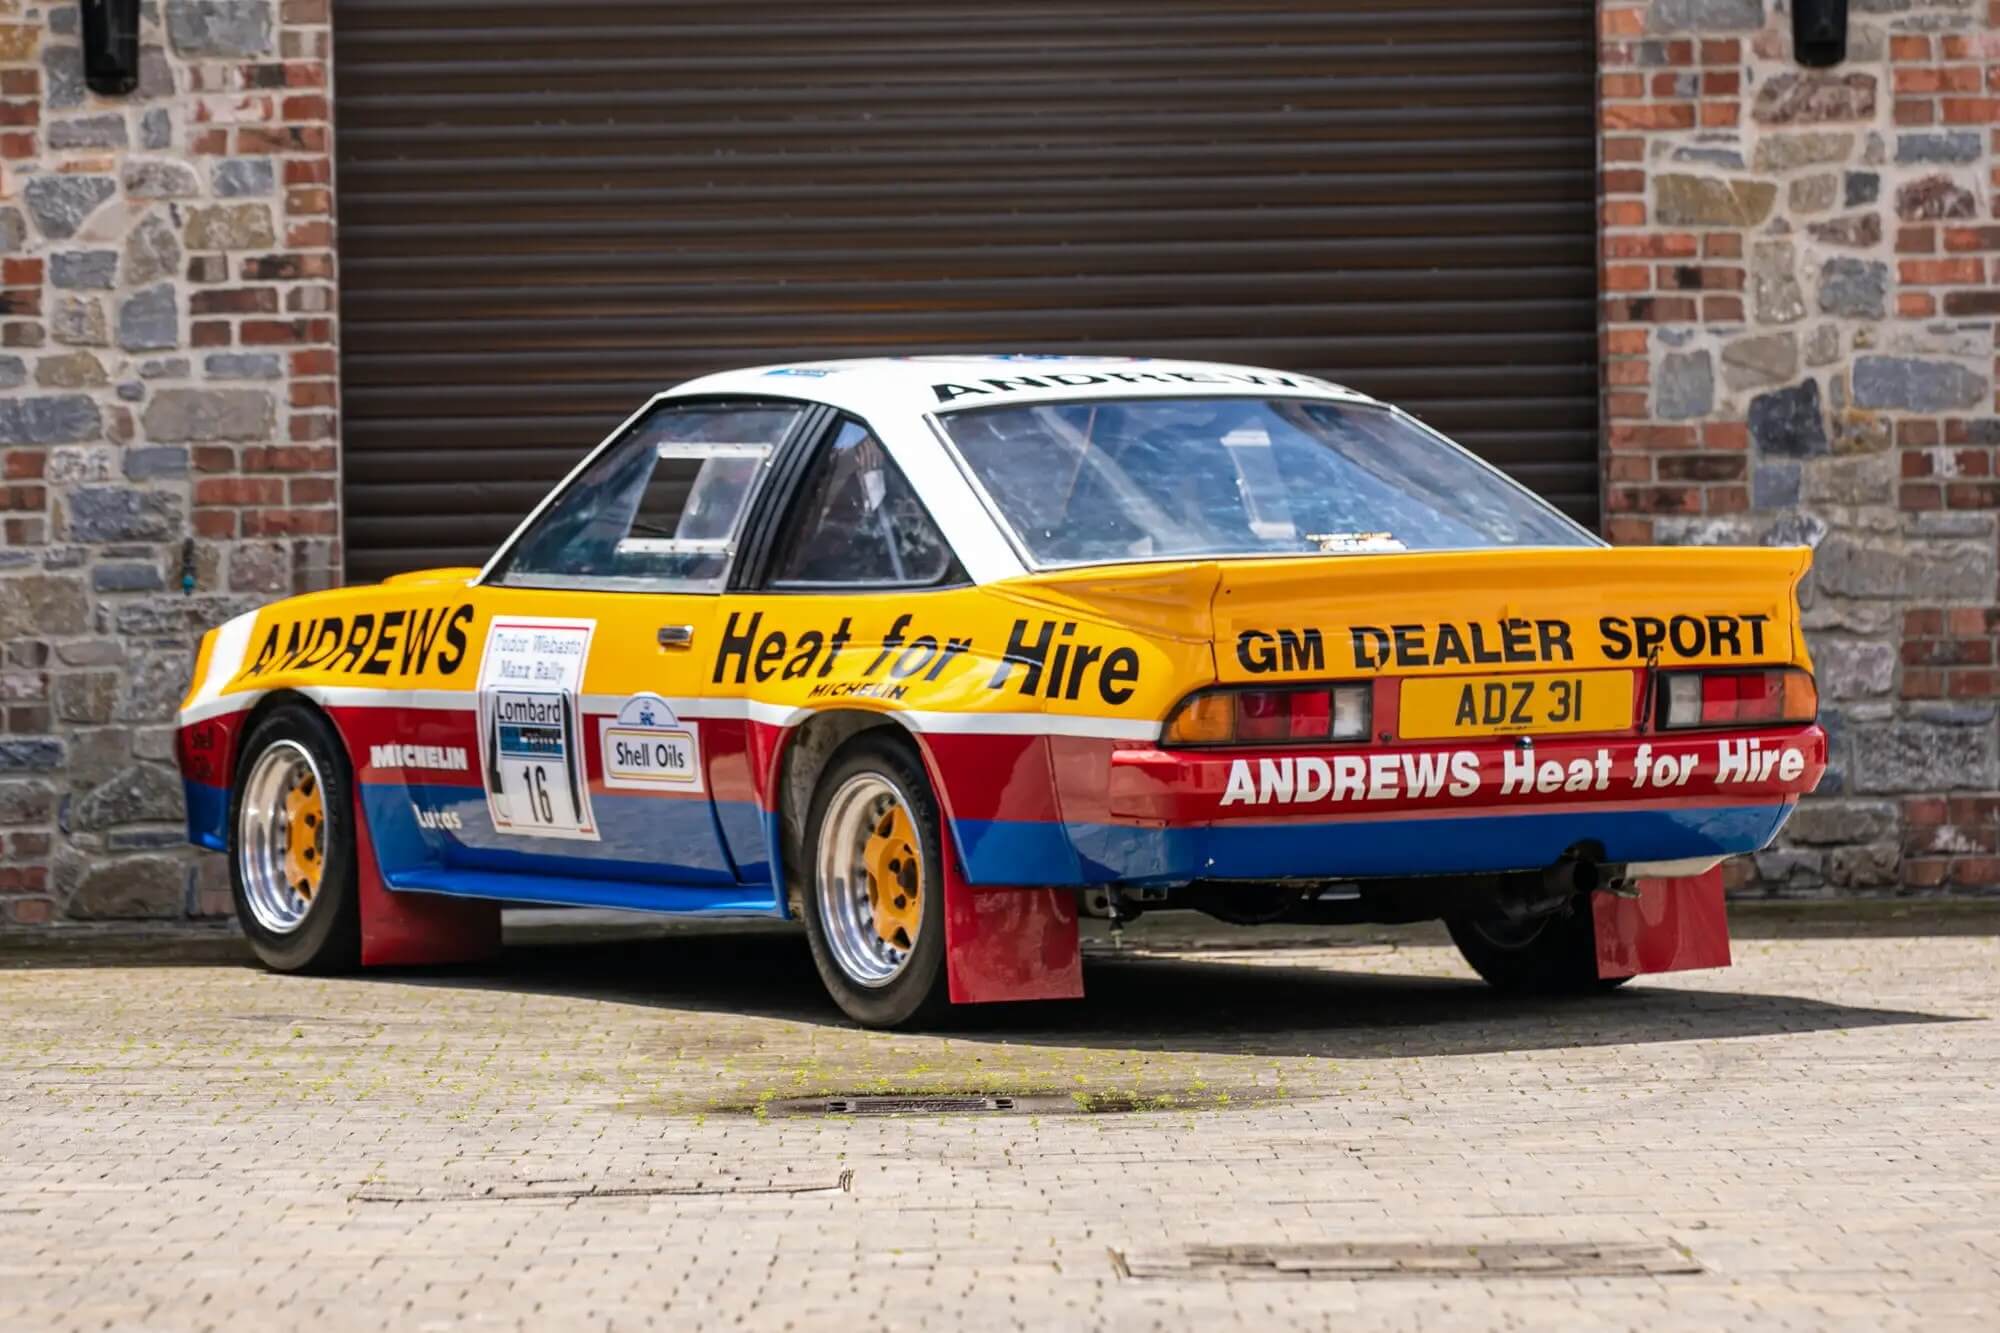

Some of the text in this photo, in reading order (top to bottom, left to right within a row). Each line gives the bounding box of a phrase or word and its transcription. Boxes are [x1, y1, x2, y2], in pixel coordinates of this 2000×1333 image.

[237, 604, 474, 682] ANDREWS
[712, 611, 1140, 705] Heat for Hire
[1236, 614, 1771, 673] GM DEALER SPORT
[496, 695, 561, 722] Lombard
[808, 682, 909, 700] MICHELIN
[1455, 679, 1583, 726] ADZ 31
[370, 744, 468, 771] MICHELIN
[616, 741, 685, 769] Shell Oils
[1219, 737, 1805, 806] ANDREWS Heat for Hire
[523, 765, 554, 824] 16
